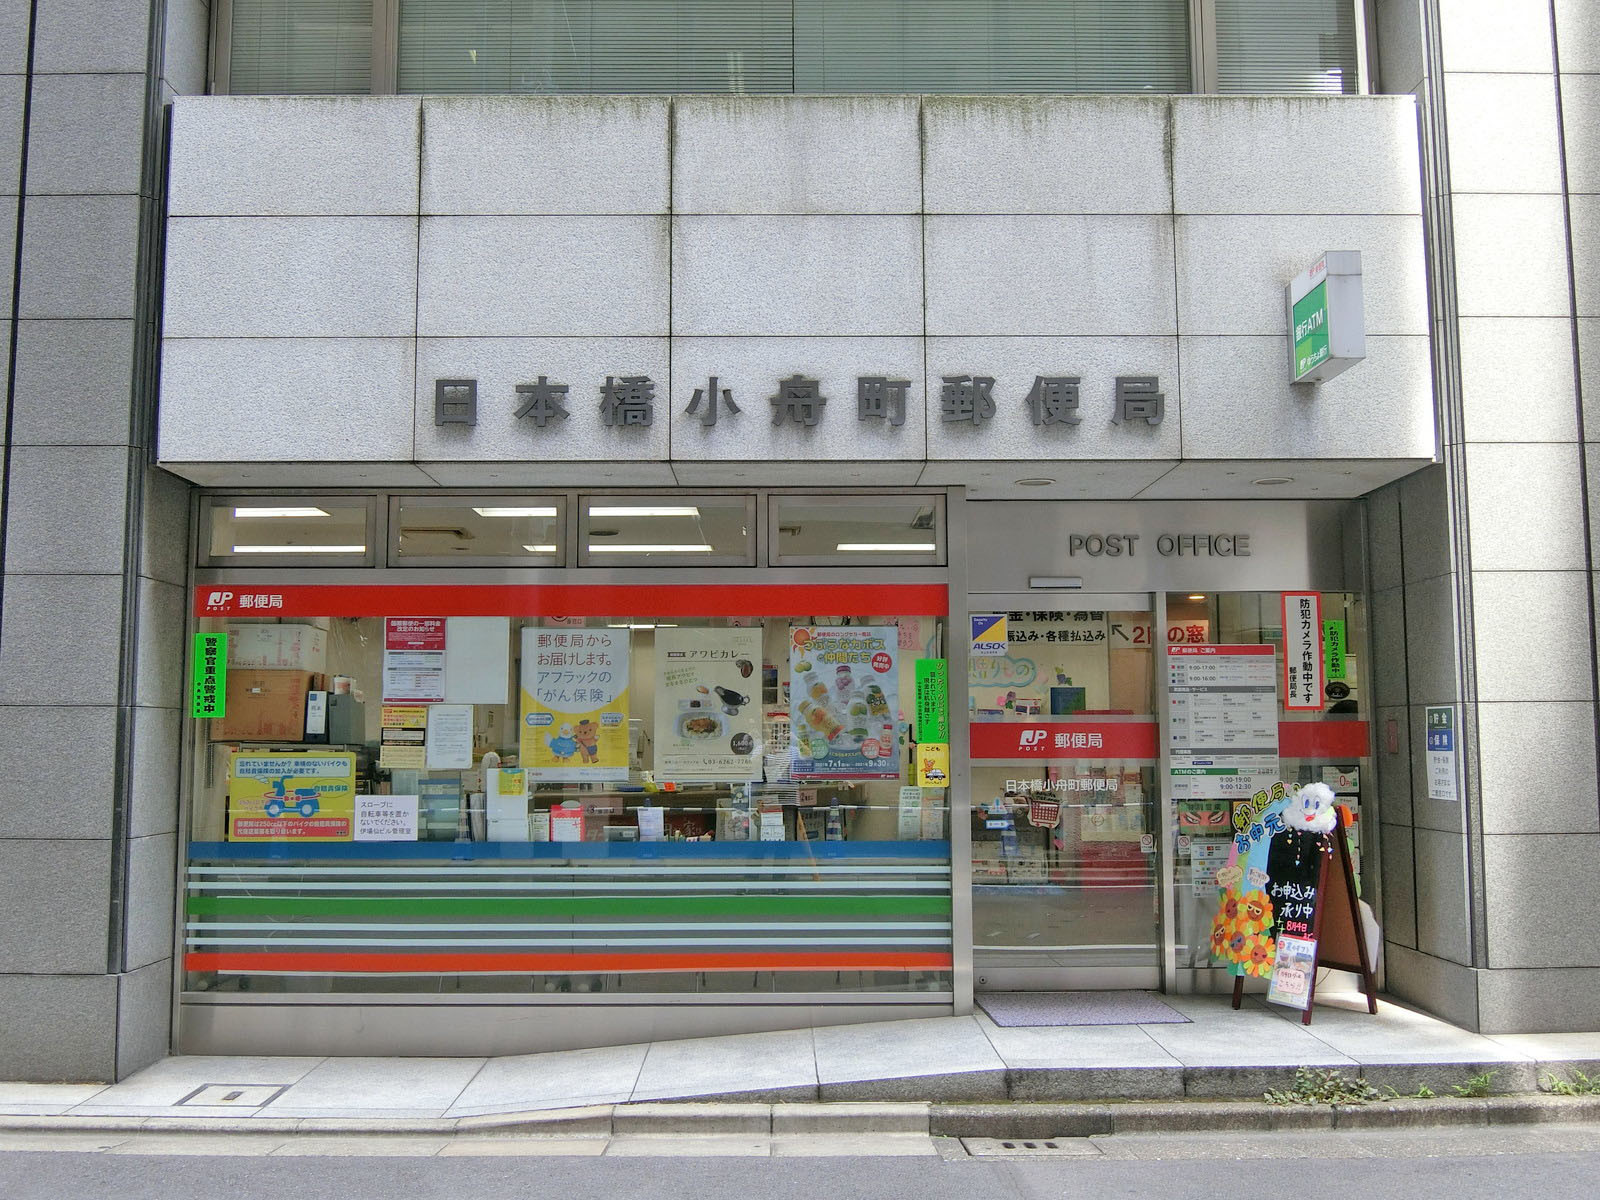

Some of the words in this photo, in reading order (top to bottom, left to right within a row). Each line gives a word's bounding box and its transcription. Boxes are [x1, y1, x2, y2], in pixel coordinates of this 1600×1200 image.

[435, 375, 1165, 427] 日本橋小舟町郵便局
[1069, 535, 1140, 557] POST
[1156, 534, 1251, 557] OFFICE
[240, 595, 283, 608] 郵便局
[538, 634, 612, 648] 郵便局から
[804, 638, 886, 651] つぶらなカボス
[690, 650, 750, 659] アワビカレー
[1300, 598, 1313, 703] 防犯カメラ作動中です
[538, 653, 612, 666] お届けします。
[204, 637, 217, 713] 警察官重点警戒中
[538, 671, 612, 684] アフラックの
[537, 688, 612, 703] 「がん保険」
[1055, 733, 1103, 748] 郵便局
[1006, 779, 1118, 792] 日本橋小舟町郵便局
[1235, 812, 1285, 853] お中元
[1271, 881, 1316, 901] お申込み
[1280, 902, 1314, 919] 承り中
